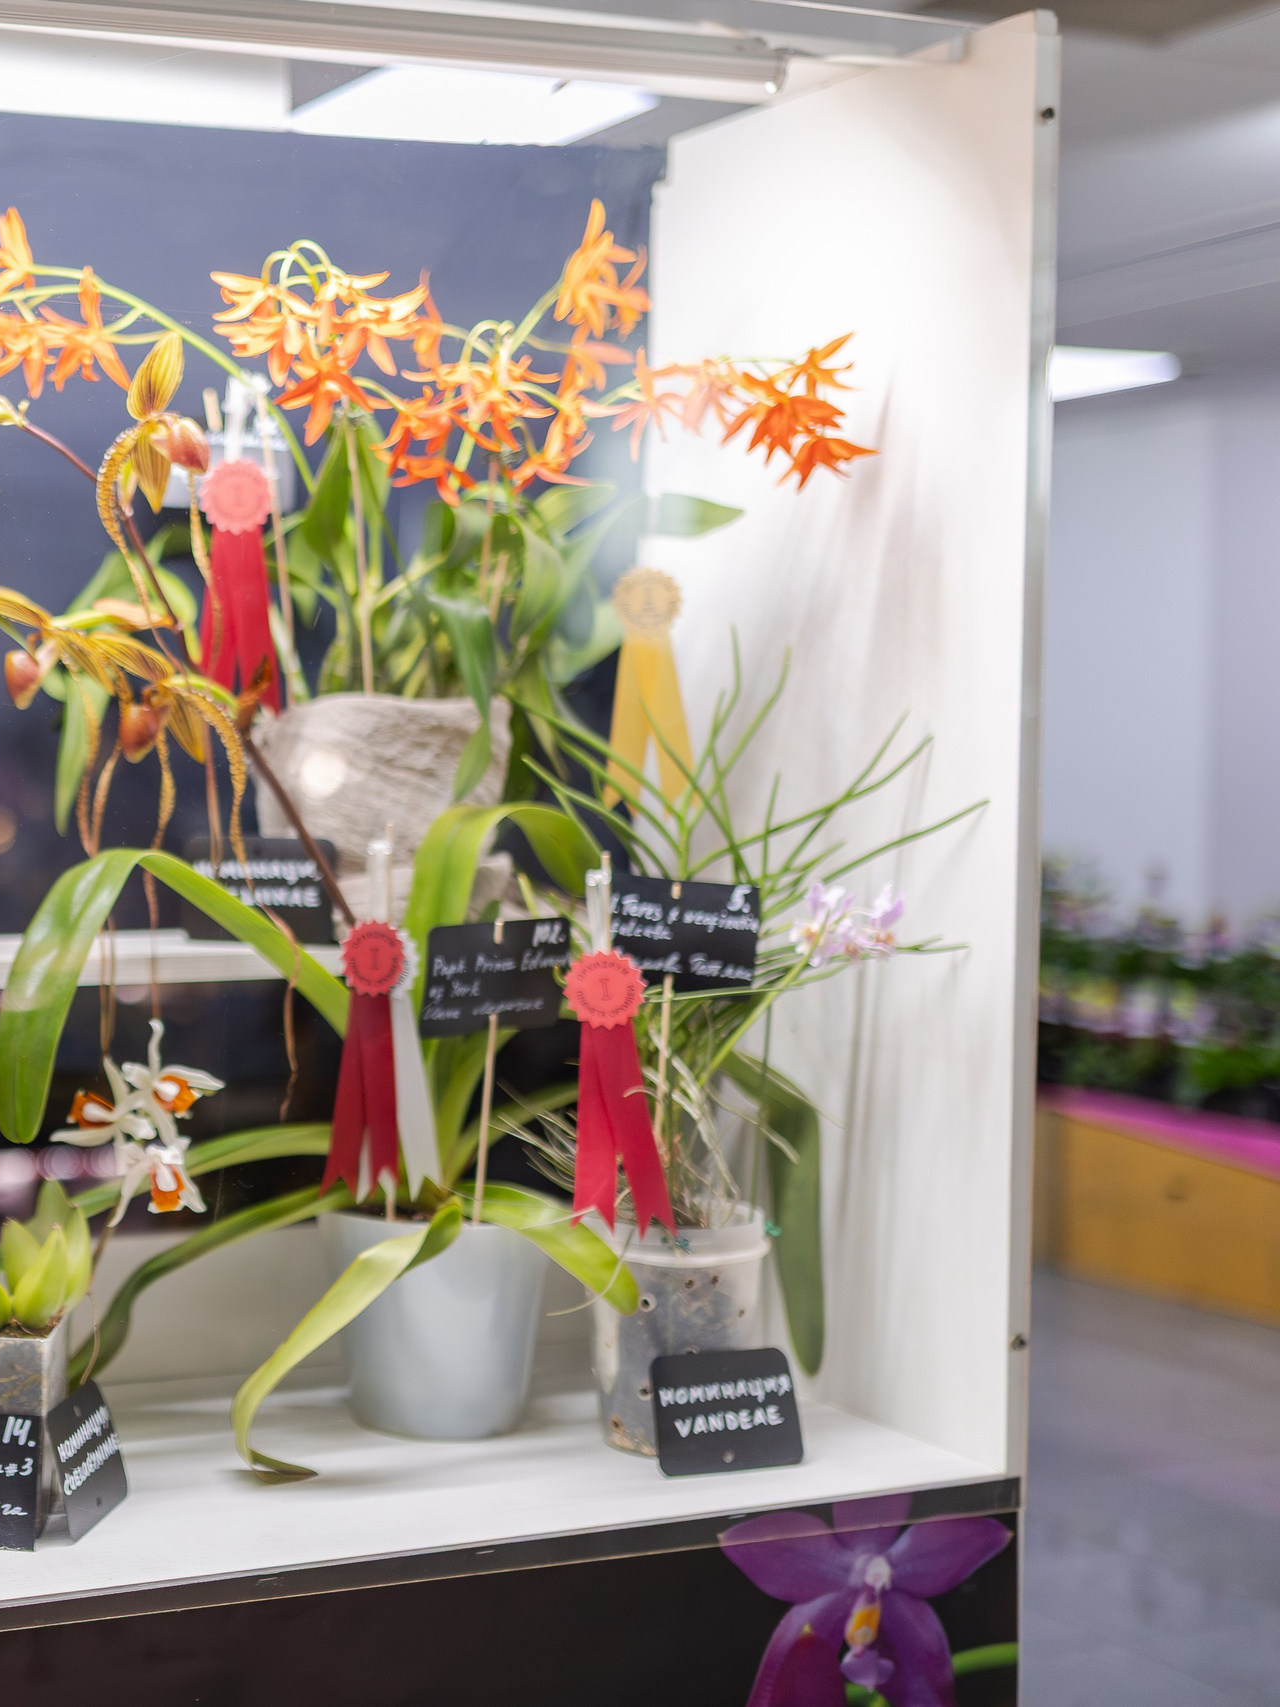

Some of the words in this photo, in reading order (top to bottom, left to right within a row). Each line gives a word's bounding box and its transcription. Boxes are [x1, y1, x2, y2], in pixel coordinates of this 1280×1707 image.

[657, 1373, 793, 1407] НОМИНАЦИЯ
[1, 1415, 37, 1448] 14.
[673, 1404, 786, 1438] VANDEAE
